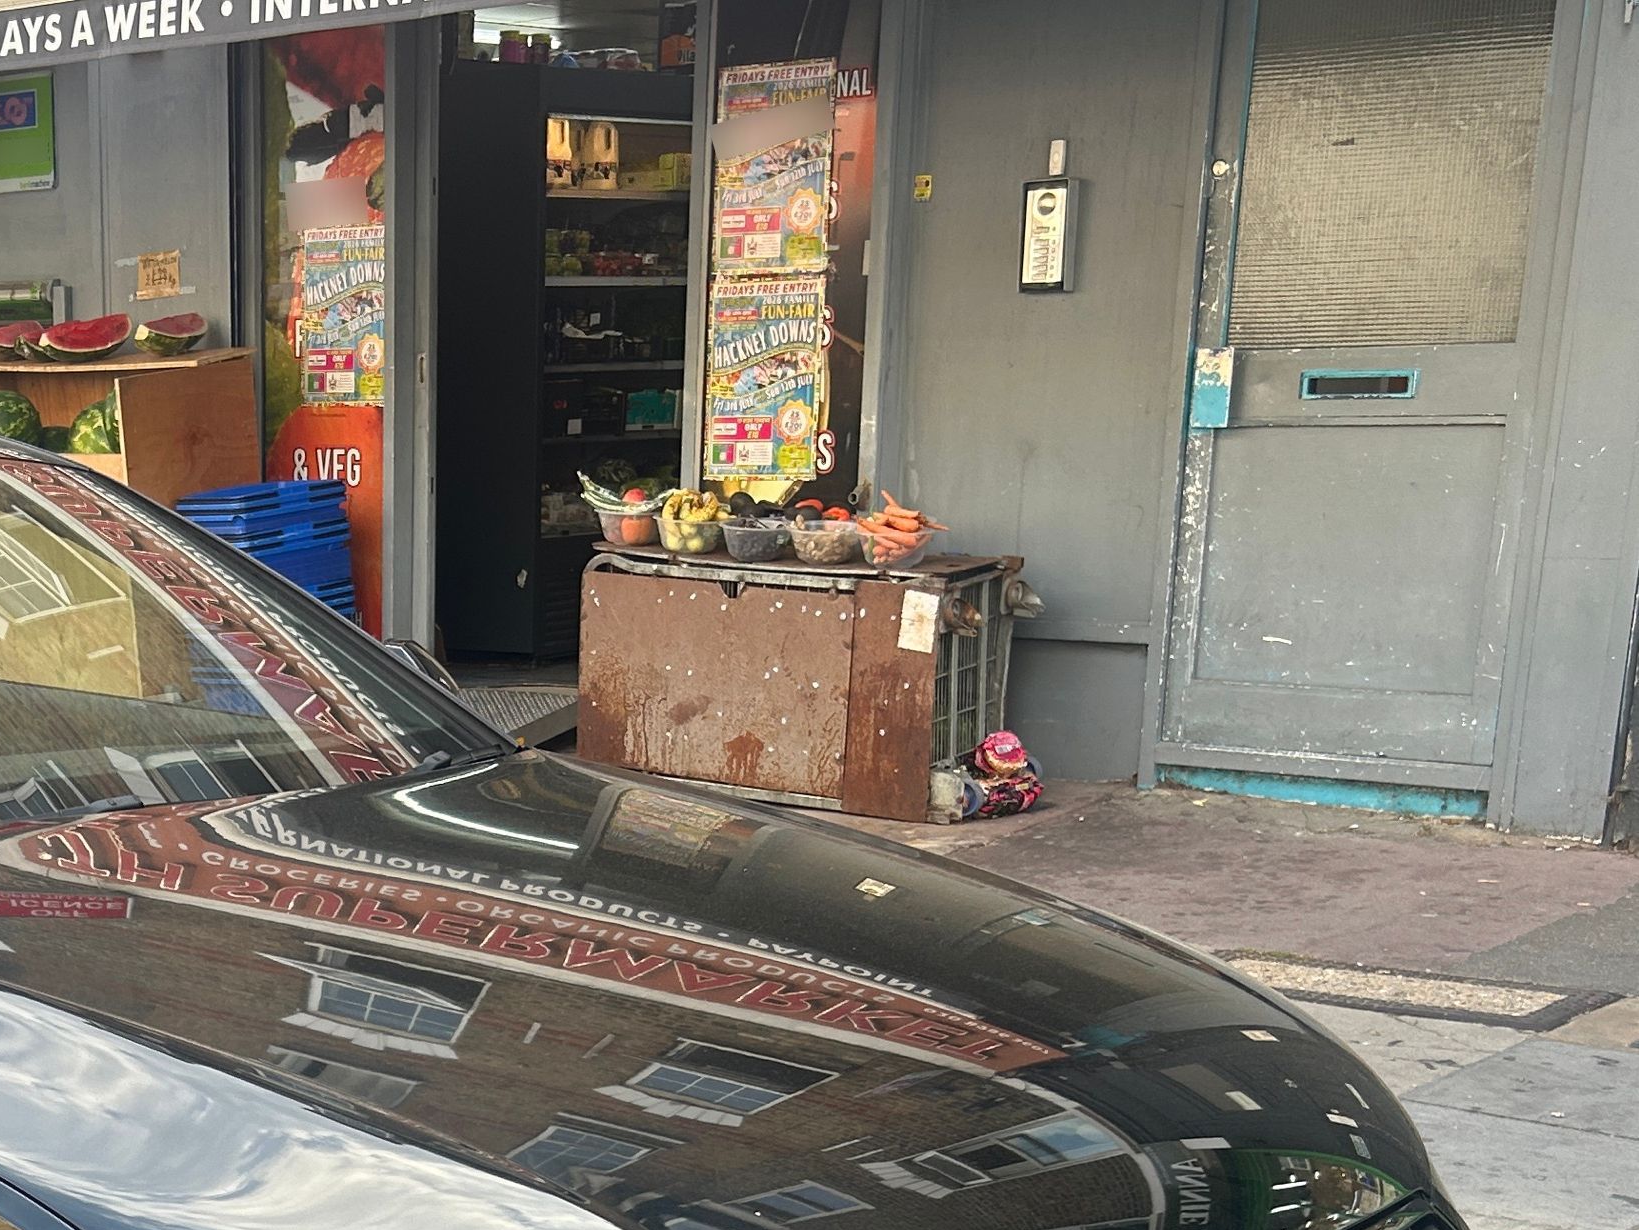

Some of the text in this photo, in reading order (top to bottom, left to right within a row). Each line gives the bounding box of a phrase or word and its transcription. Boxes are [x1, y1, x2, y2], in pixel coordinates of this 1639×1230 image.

[70, 14, 96, 47] A
[103, 1, 206, 42] WEEK
[249, 0, 432, 24] INTE
[726, 64, 830, 84] FRIDAYS FREE ENTRY!
[836, 69, 872, 98] NAL
[307, 231, 337, 241] FRIDAYS
[339, 229, 358, 239] FREE
[343, 247, 385, 261] FUN-FAIR
[306, 261, 385, 305] HACKNEY DOWNS
[717, 282, 818, 296] FRIDAYS FREE ENTRY!
[762, 304, 815, 319] FUN-FAIR
[714, 330, 767, 369] HACKNEY
[769, 320, 817, 346] DOWNS
[293, 448, 361, 487] & VEG
